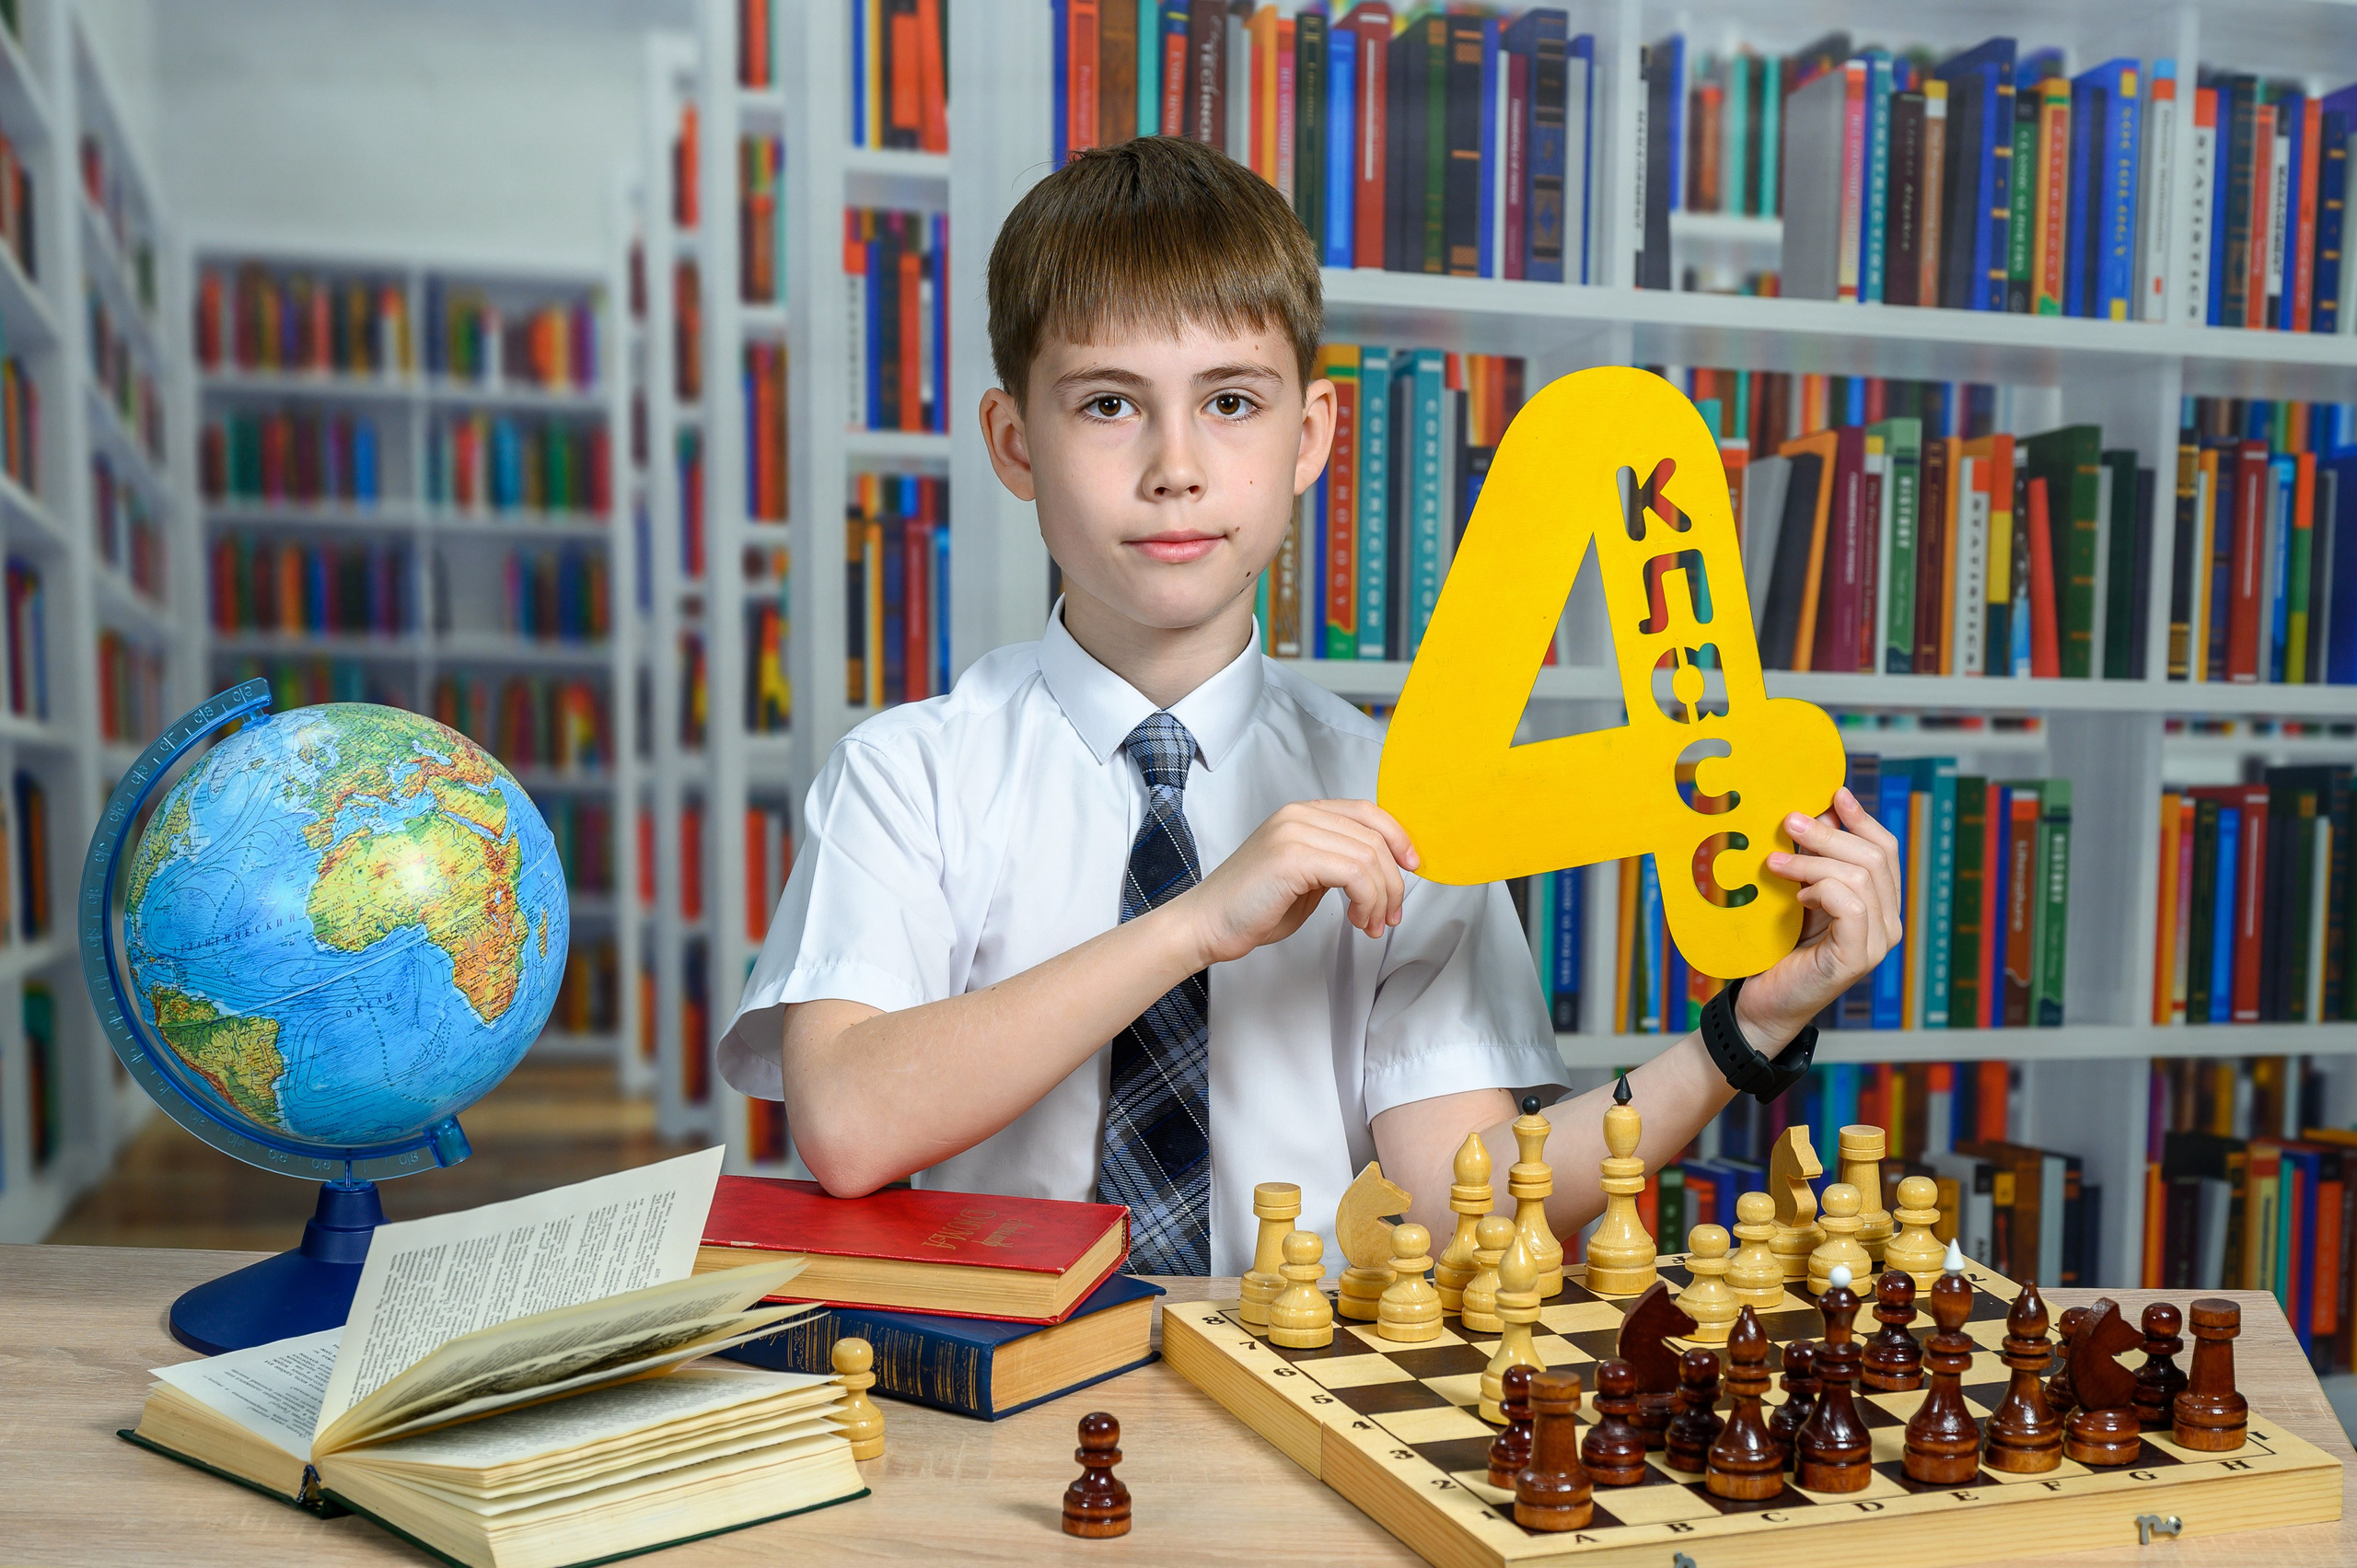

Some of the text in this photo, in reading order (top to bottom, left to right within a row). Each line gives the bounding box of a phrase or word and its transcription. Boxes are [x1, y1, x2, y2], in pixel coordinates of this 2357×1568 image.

[1333, 404, 1351, 608] PSYCHOLOGY
[1366, 396, 1384, 629] CONSTRUCTION
[345, 991, 393, 1018] ОКЕАН
[1202, 1317, 1225, 1325] 8
[1239, 1342, 1257, 1350] 7
[1273, 1368, 1296, 1376] 6
[1310, 1395, 1333, 1404] 5
[1352, 1421, 1376, 1430] 4
[1389, 1450, 1415, 1459] 3
[1431, 1480, 1457, 1490] 2
[1574, 1459, 2254, 1544] A B C D E F G H
